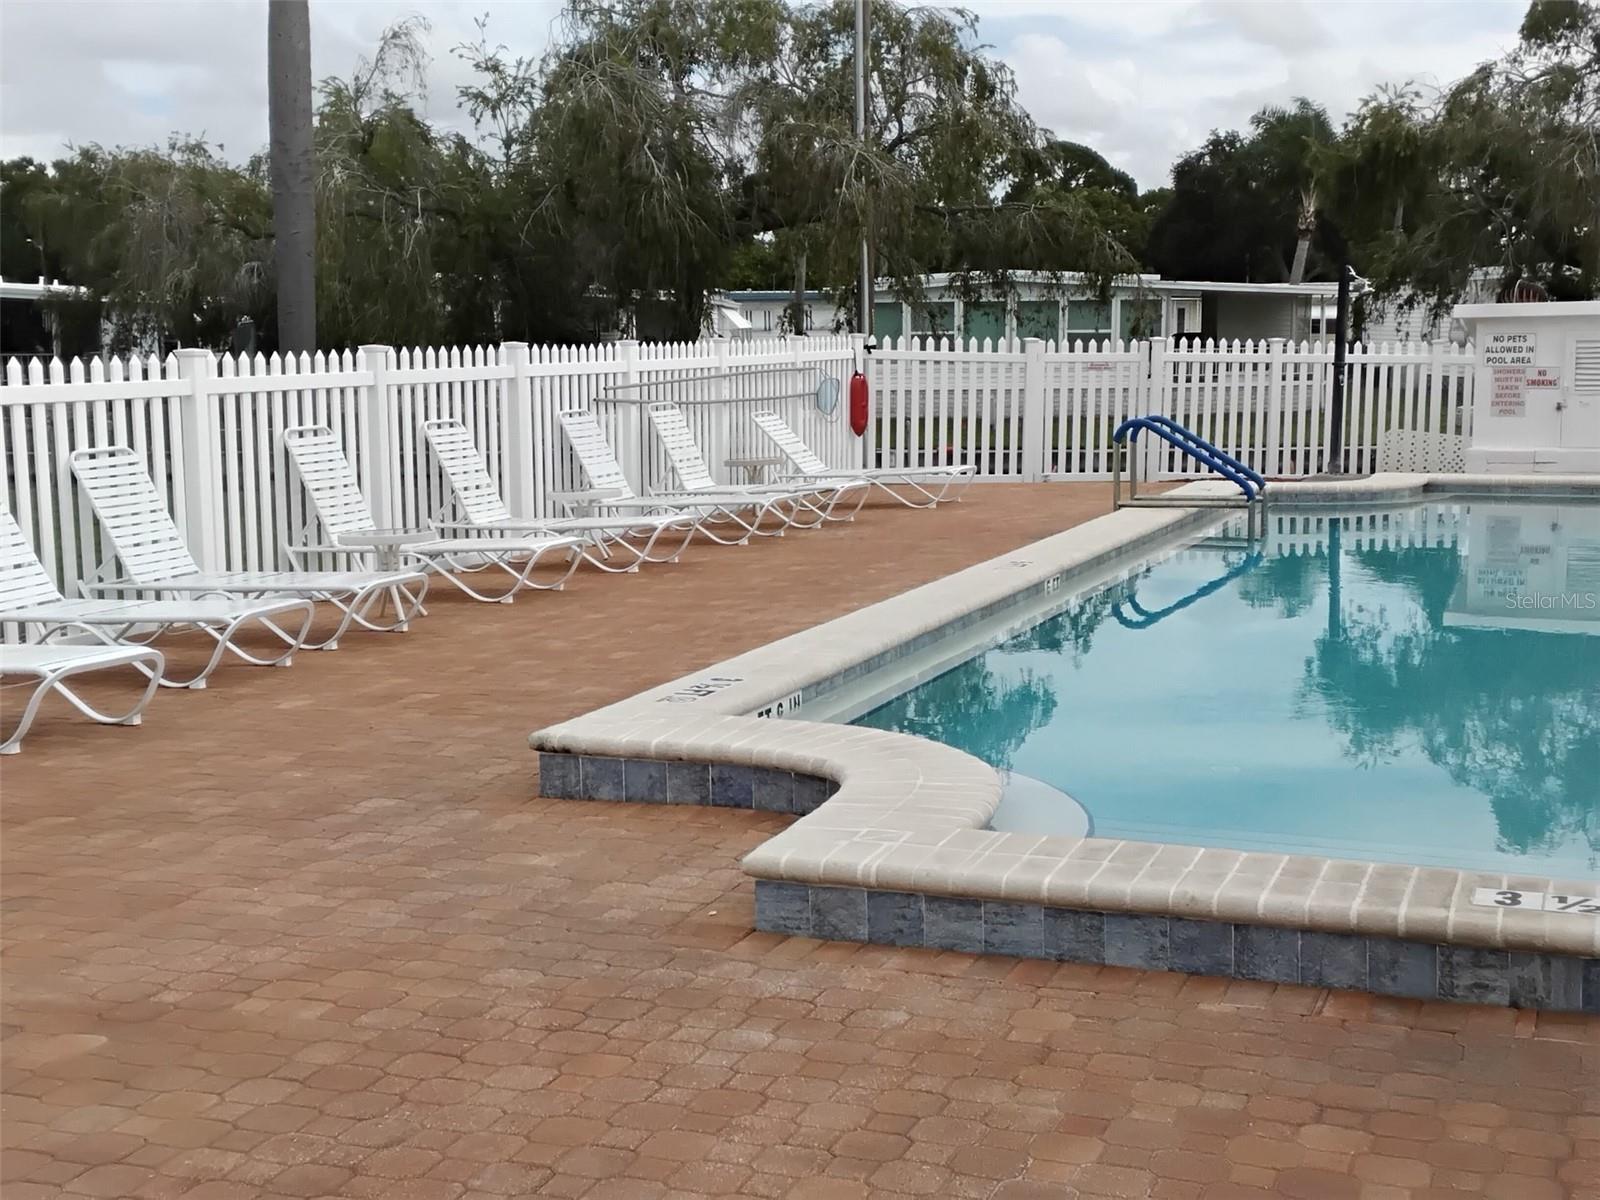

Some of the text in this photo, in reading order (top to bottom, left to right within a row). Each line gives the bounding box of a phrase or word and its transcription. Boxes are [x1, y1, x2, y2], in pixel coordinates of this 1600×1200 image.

[1493, 335, 1528, 343] NO PETS
[1485, 346, 1524, 354] ALLOWED
[1486, 356, 1532, 364] POOL AREA
[1537, 369, 1547, 377] NO
[1526, 379, 1557, 387] SMOKING
[1494, 891, 1523, 907] 3
